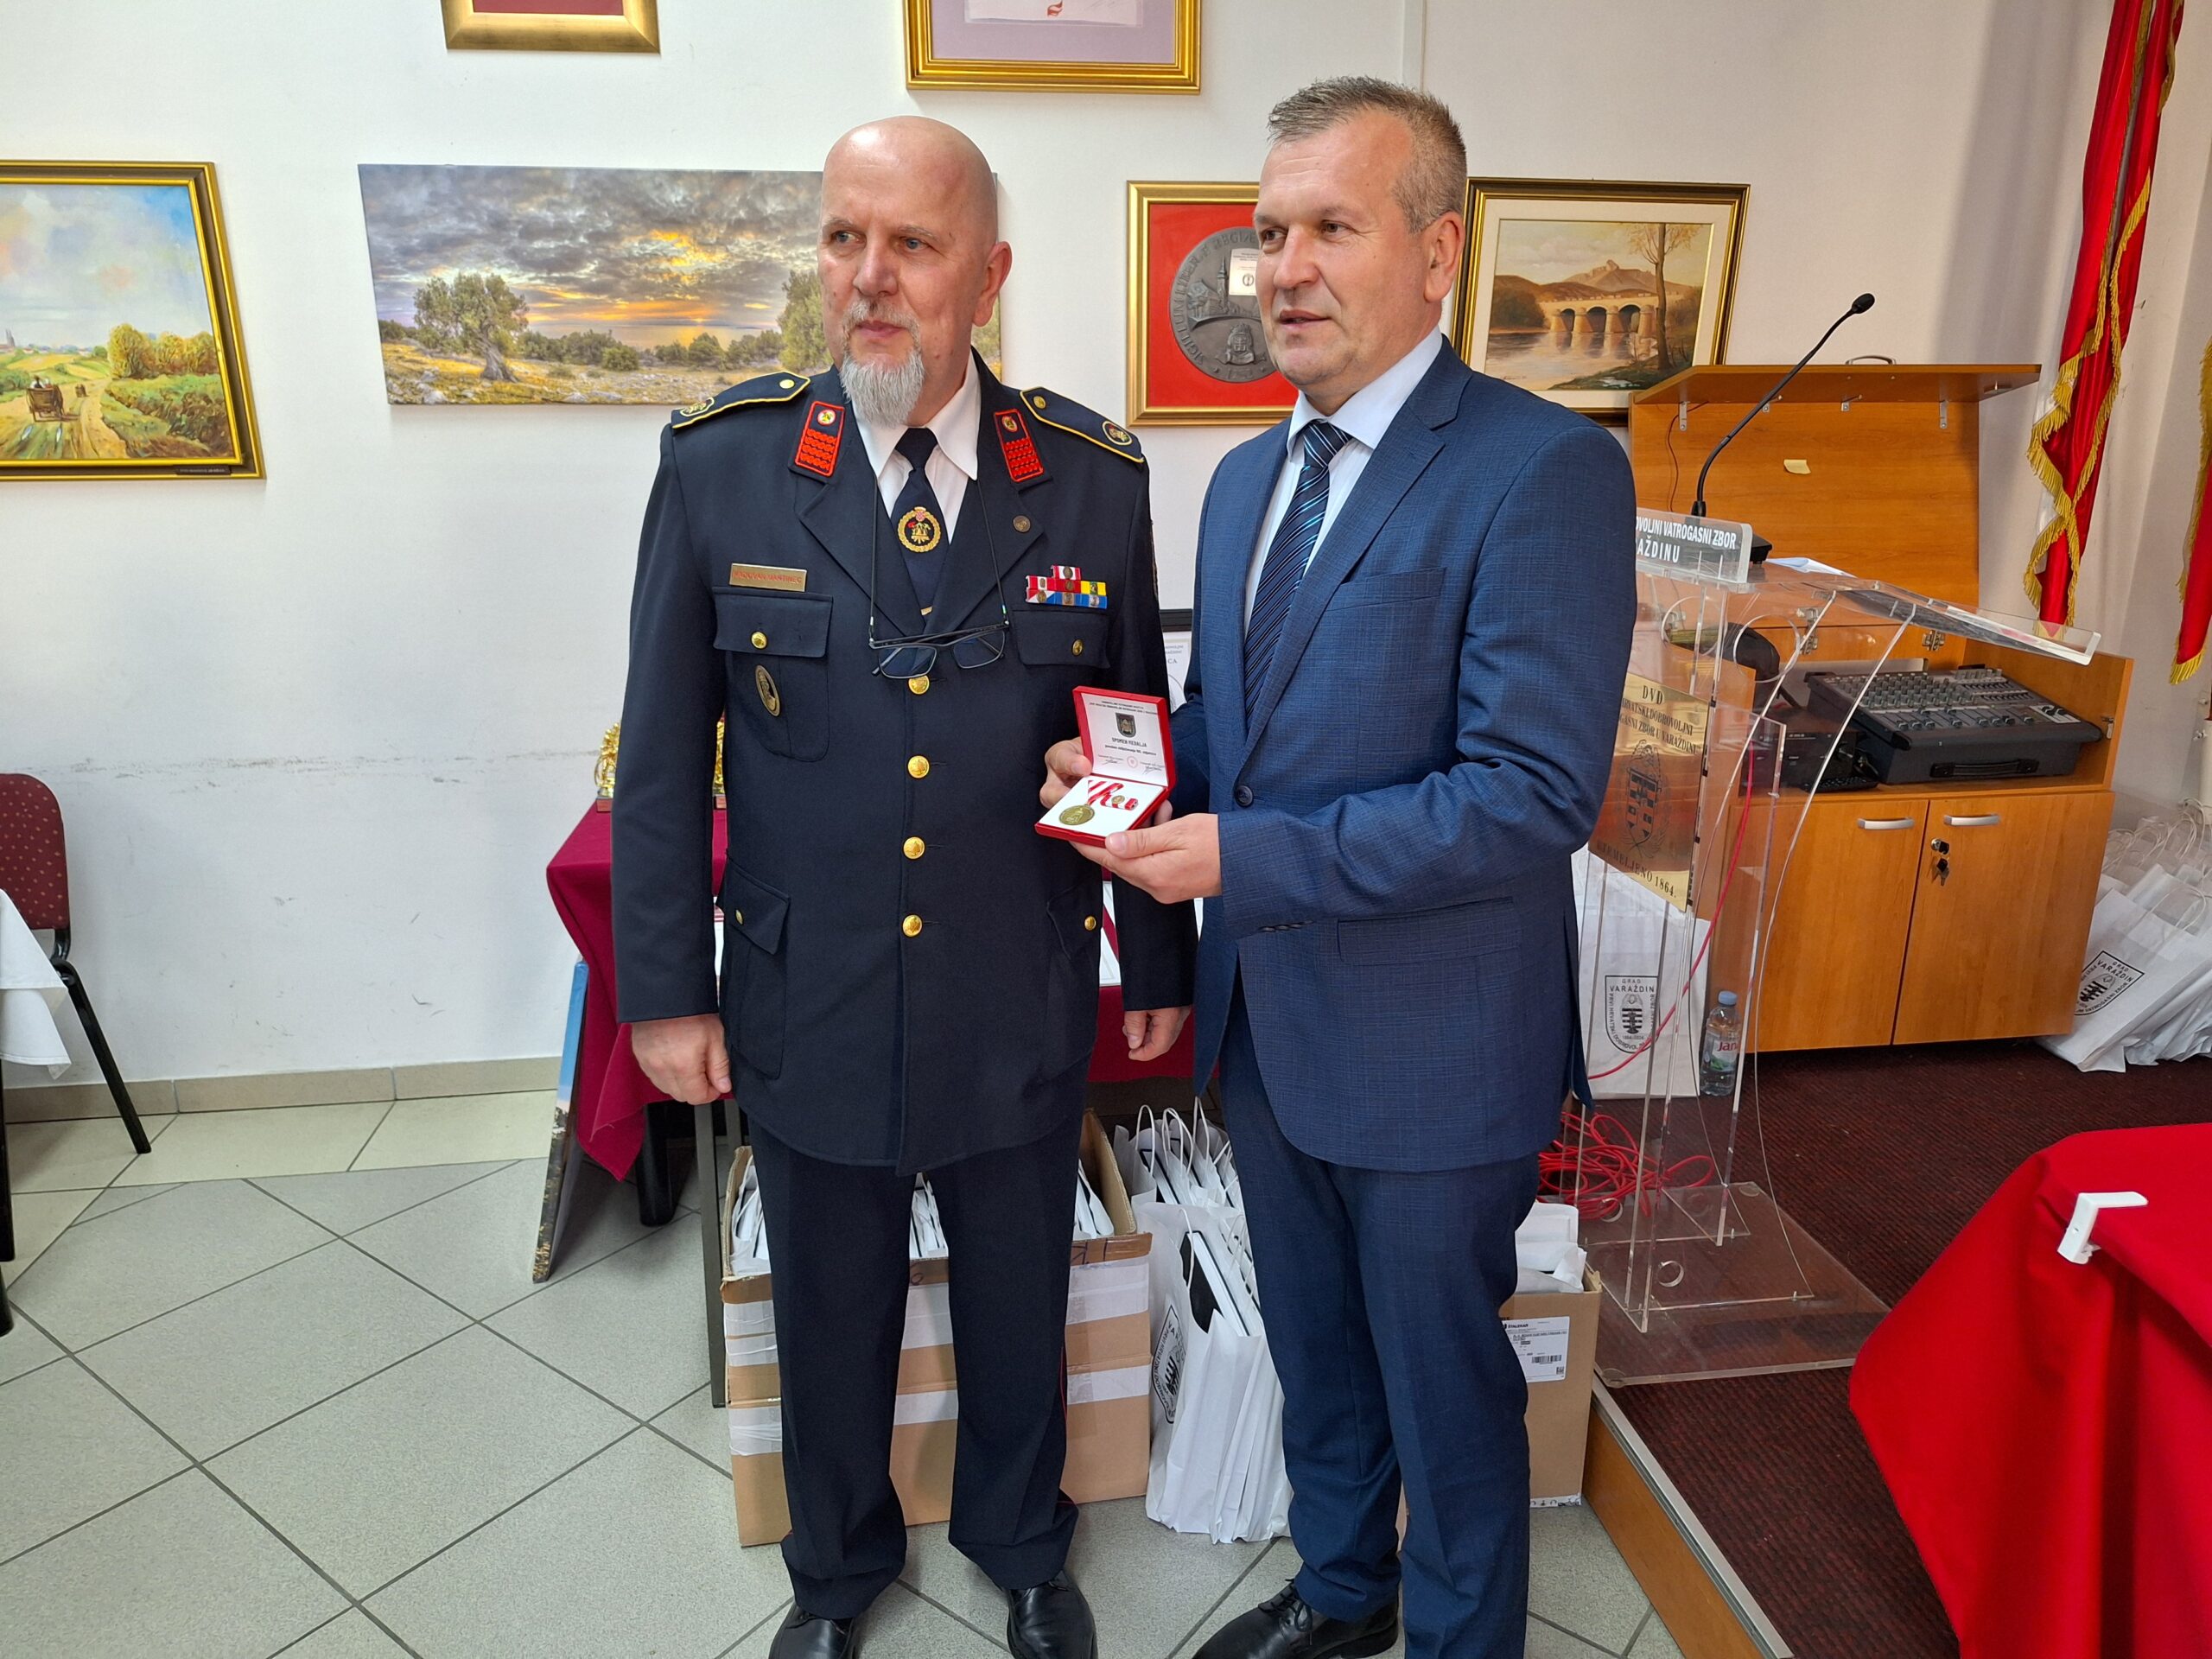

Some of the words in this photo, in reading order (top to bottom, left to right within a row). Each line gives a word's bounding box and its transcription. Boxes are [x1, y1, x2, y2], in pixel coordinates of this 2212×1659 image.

[1663, 520, 1712, 545] VATROGASNI
[1713, 530, 1737, 550] ZBOR
[1636, 535, 1681, 563] AŽDINU
[1642, 685, 1663, 705] DVD
[1638, 721, 1656, 738] ZBOR
[1649, 710, 1694, 736] DOBROVOLJNI
[1655, 876, 1677, 899] 1864.
[2097, 959, 2134, 982] VARAŽDIN
[2112, 961, 2130, 972] GRAD
[1609, 984, 1655, 993] VARAŽDIN
